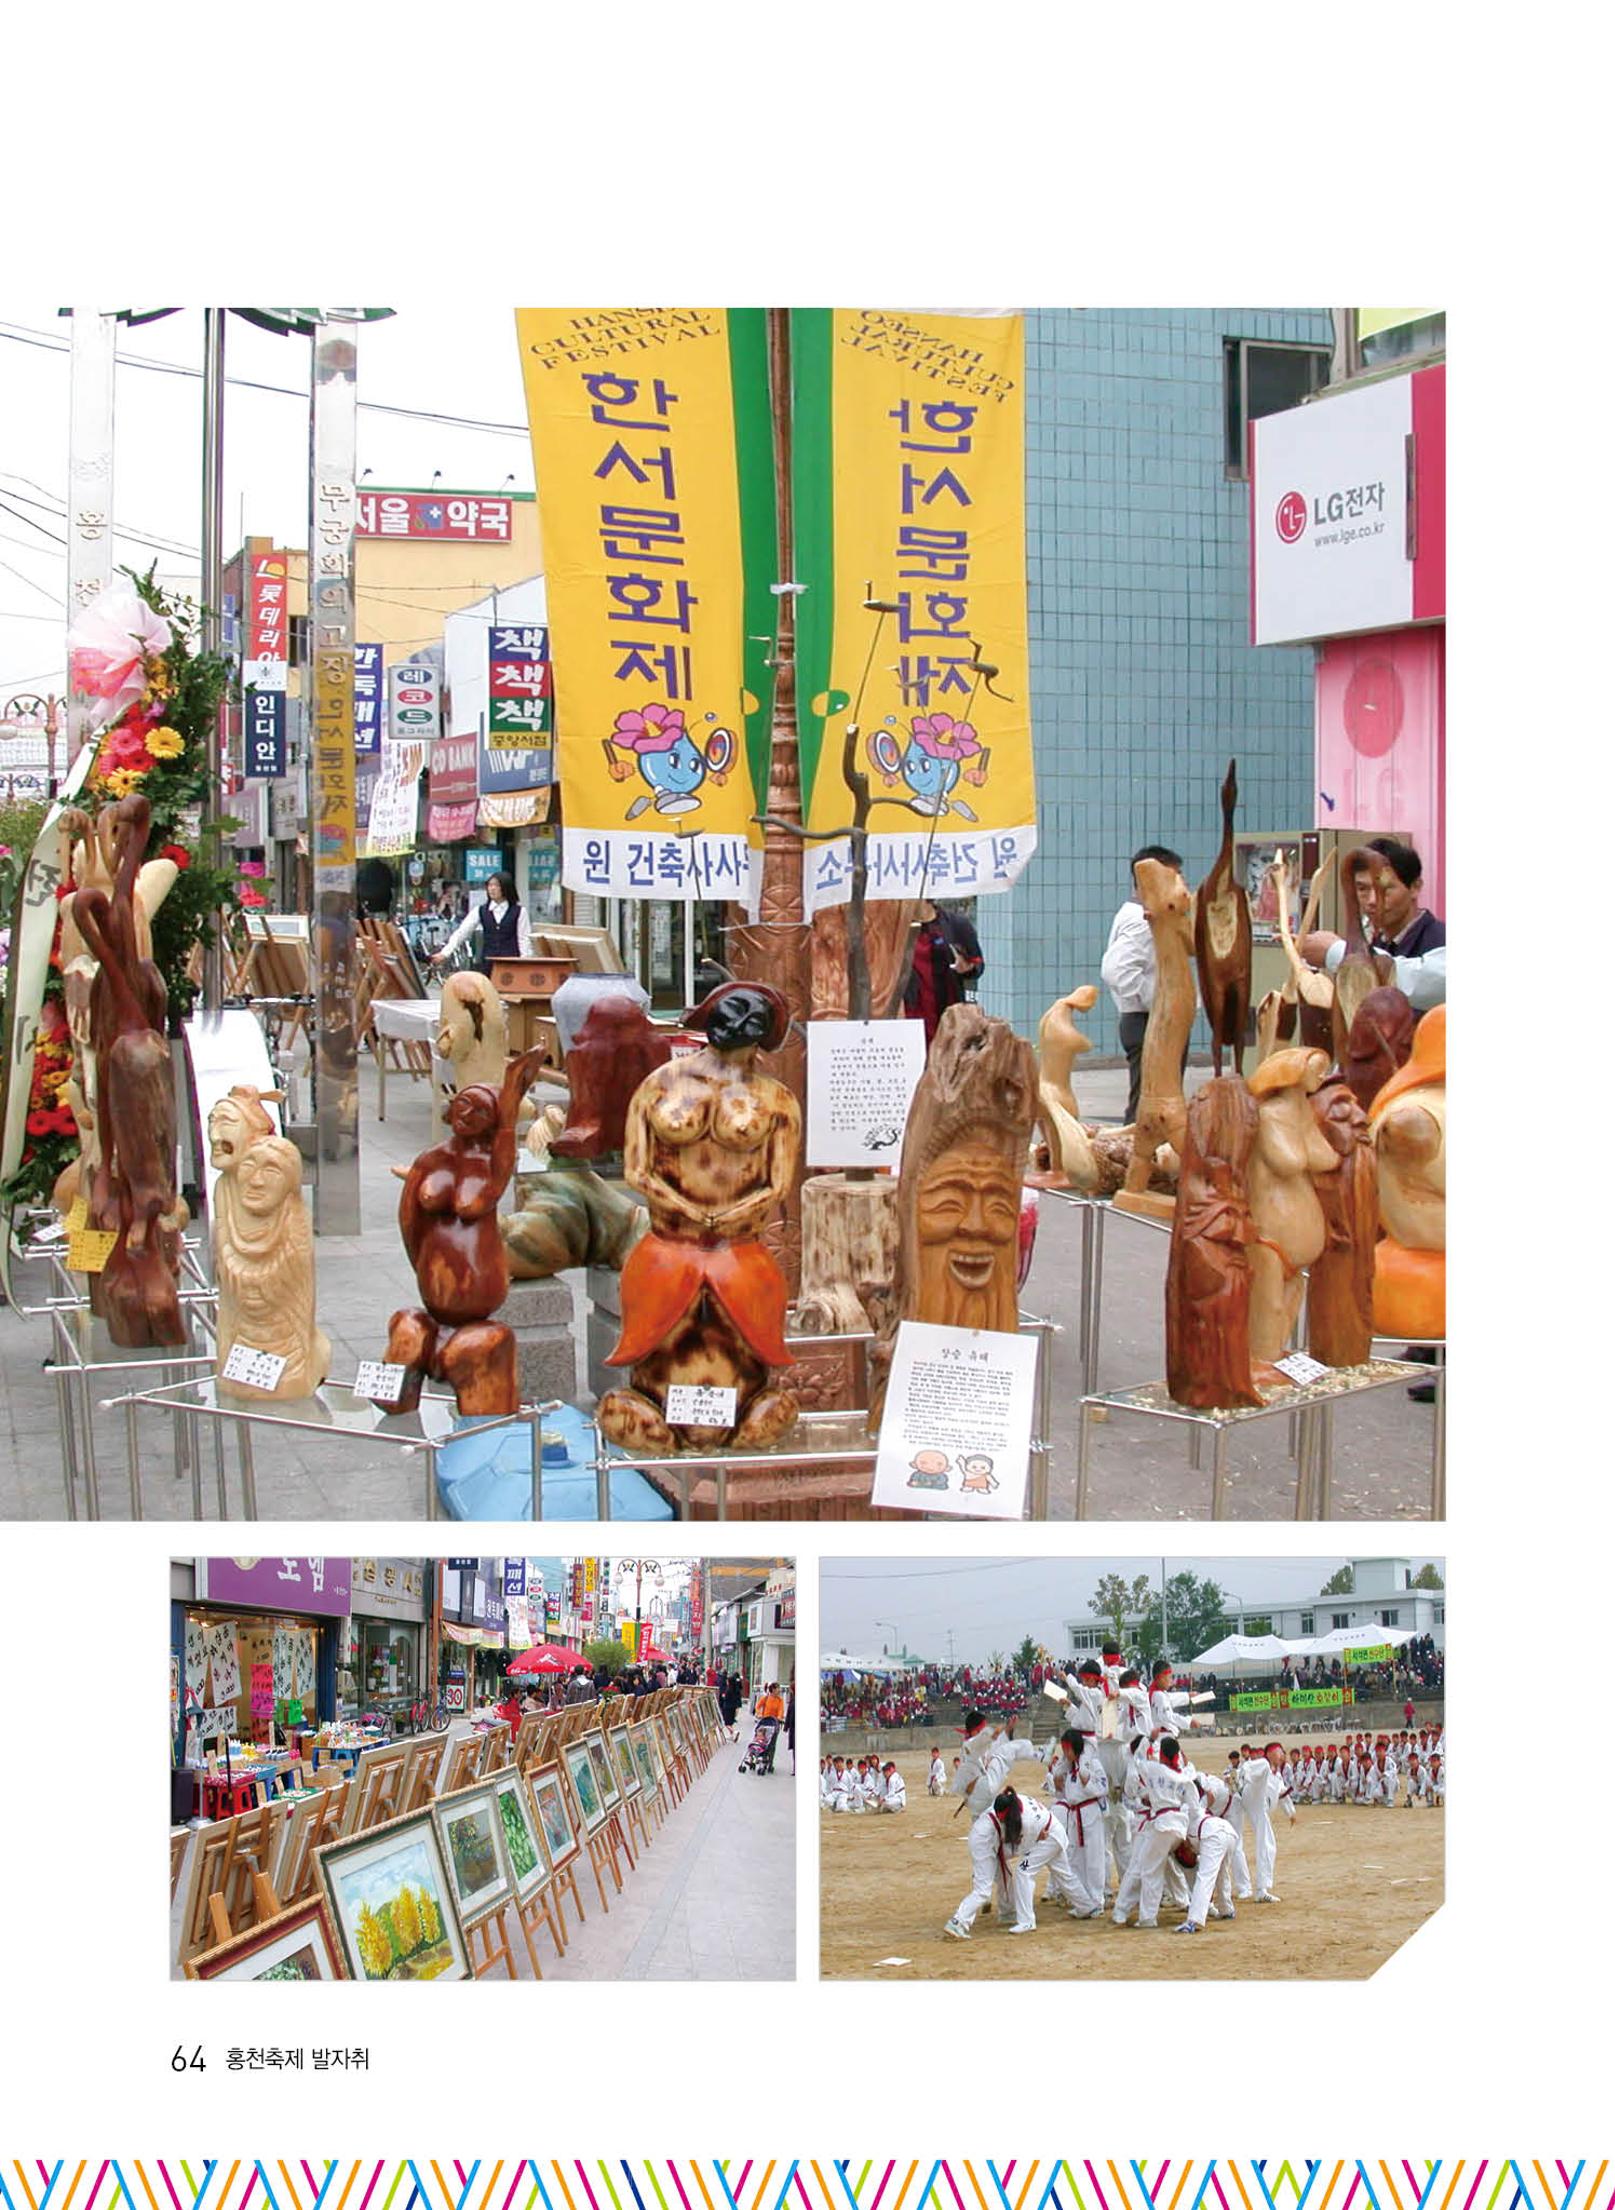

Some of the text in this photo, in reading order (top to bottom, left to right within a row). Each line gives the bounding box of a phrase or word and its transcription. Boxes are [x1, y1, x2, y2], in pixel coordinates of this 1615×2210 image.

[530, 311, 711, 355] CULTURAL
[571, 308, 675, 329] HANS
[542, 325, 720, 369] FESTIVAL
[447, 500, 509, 537] 약국
[1314, 481, 1385, 525] LG전자
[581, 371, 698, 701] 한서문화제
[1314, 521, 1385, 547] www.lge.co.kr
[257, 584, 283, 661] 롯데리아
[255, 695, 277, 760] 인디안
[468, 854, 500, 867] SALE
[583, 840, 611, 885] 원
